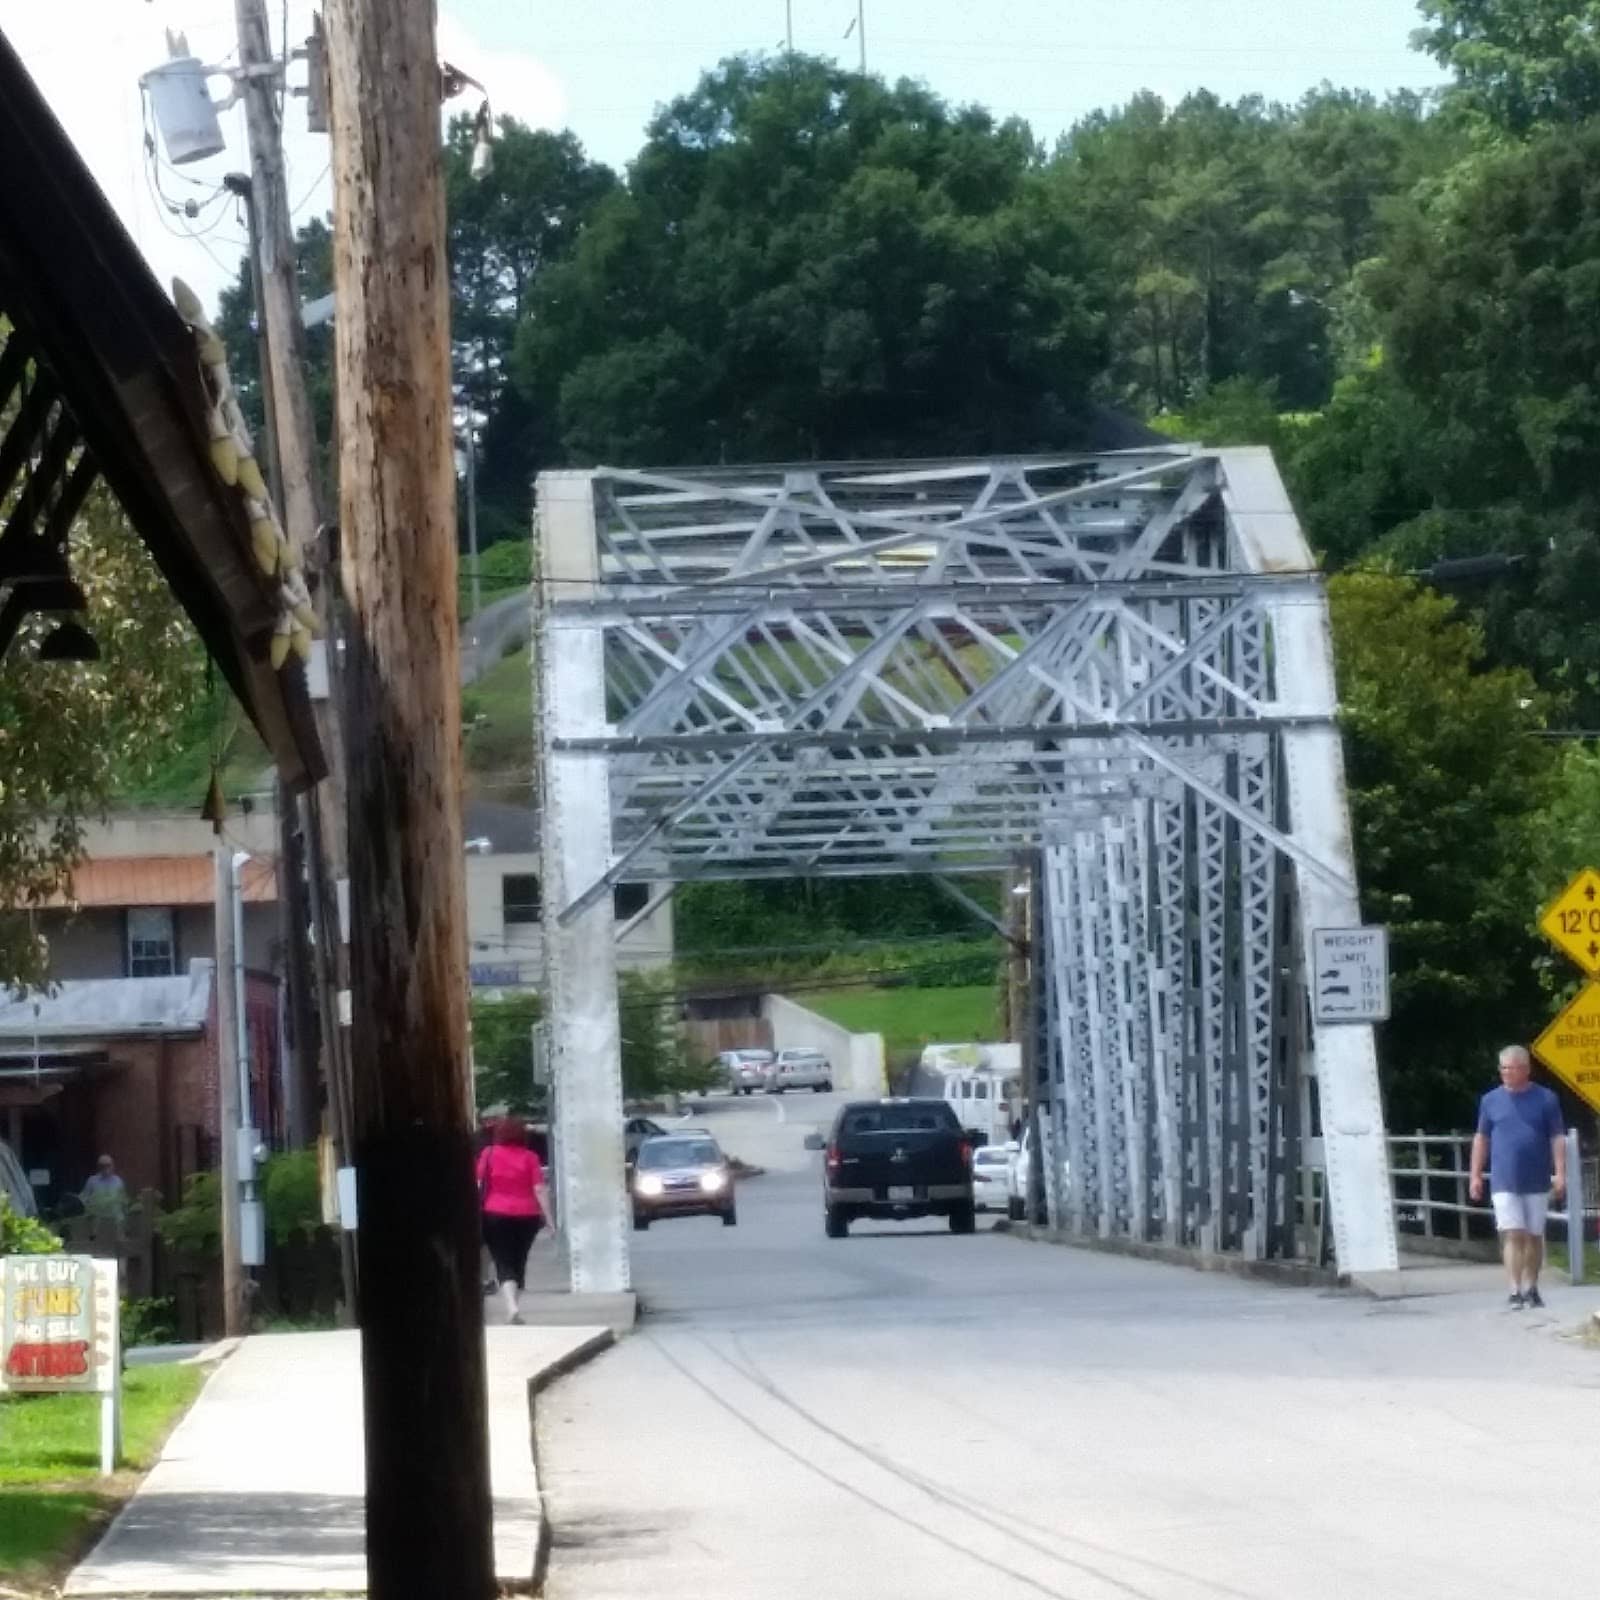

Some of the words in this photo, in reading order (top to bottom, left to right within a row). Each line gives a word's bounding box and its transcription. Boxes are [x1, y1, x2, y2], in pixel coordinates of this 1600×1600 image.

[1323, 936, 1374, 947] WEIGHT
[1331, 951, 1366, 963] LIMIT
[14, 1263, 40, 1283] WE
[46, 1261, 80, 1282] BUY
